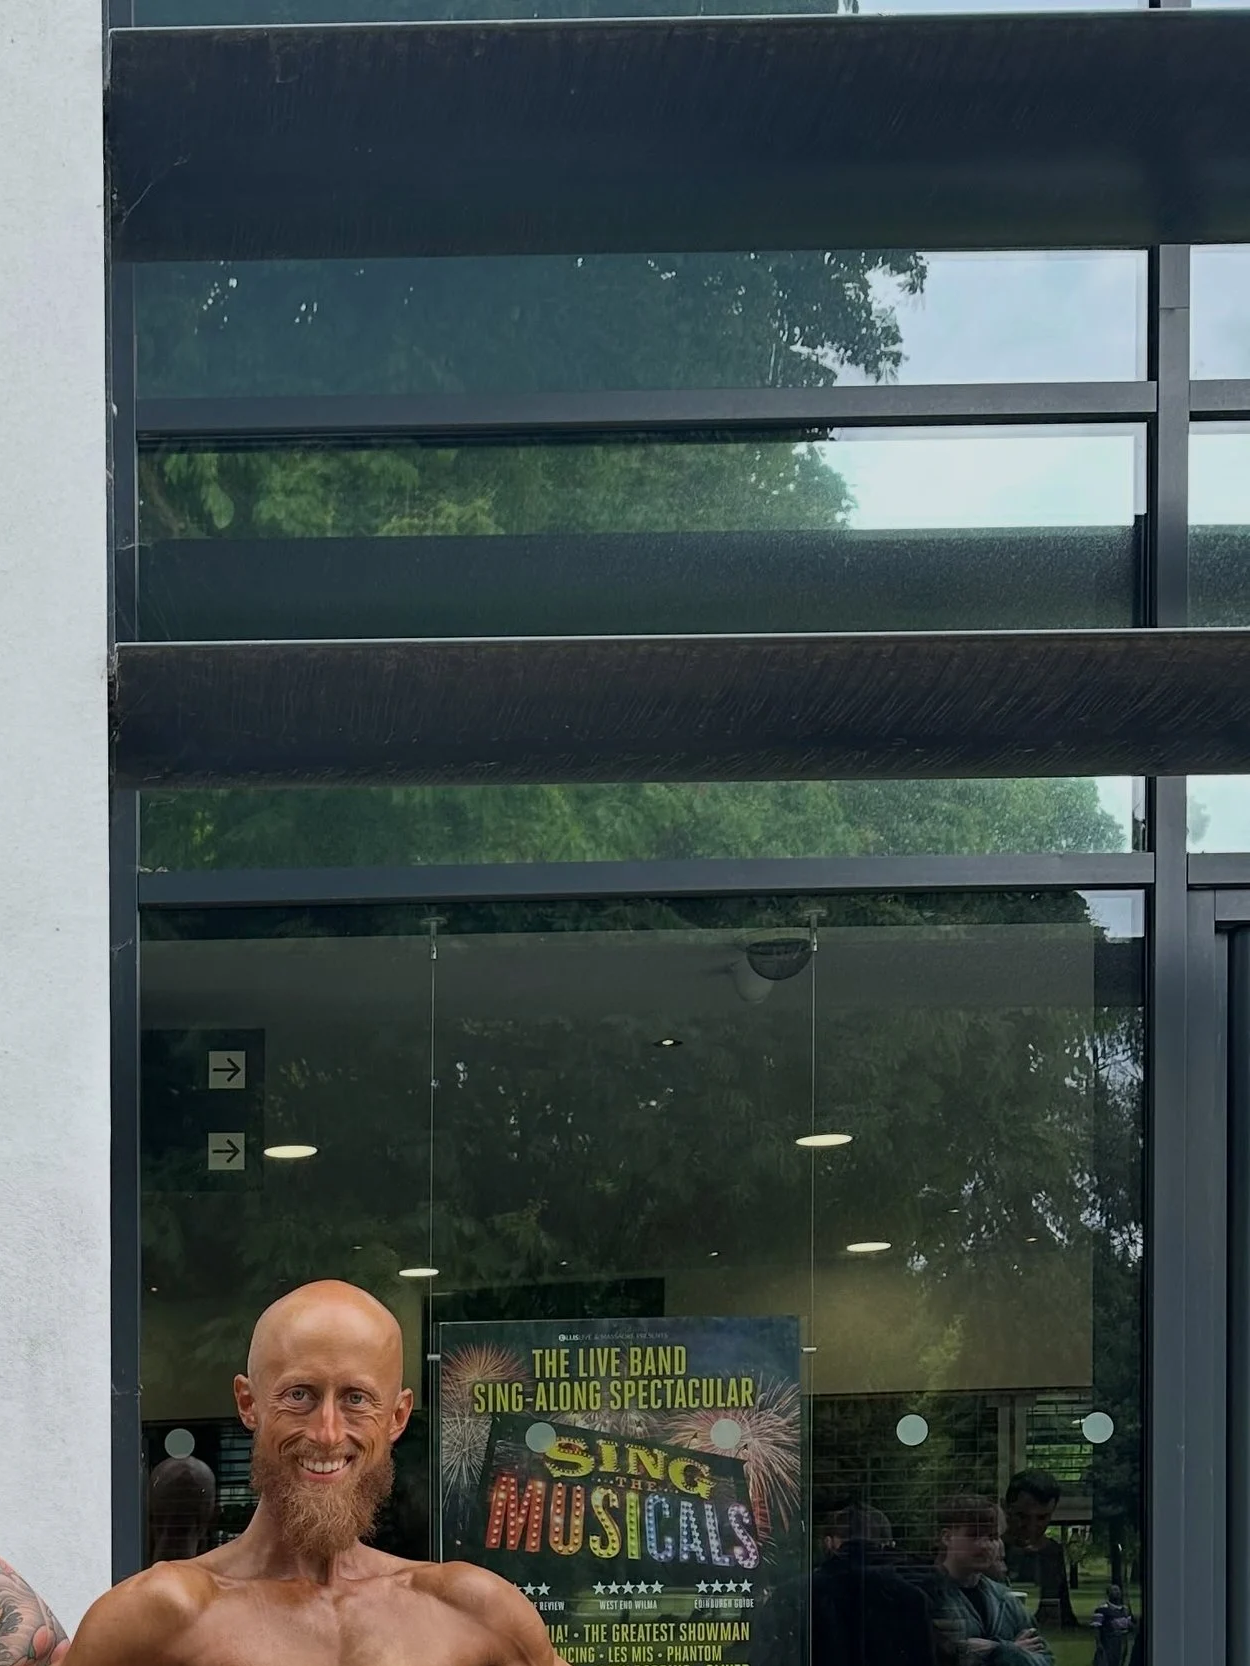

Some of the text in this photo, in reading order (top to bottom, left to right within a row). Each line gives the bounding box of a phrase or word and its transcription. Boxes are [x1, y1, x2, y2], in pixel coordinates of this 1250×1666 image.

[532, 1346, 686, 1379] THE LIVE BAND
[473, 1378, 754, 1413] SING-ALONG SPECTACULAR
[544, 1436, 716, 1499] SING
[485, 1474, 760, 1569] MUSICALS
[539, 1601, 565, 1611] REVIEW
[599, 1600, 658, 1611] WEST END WILMA
[694, 1597, 755, 1609] EDINBURGH GUIDE
[584, 1624, 607, 1643] THE
[612, 1623, 675, 1642] GREATEST
[679, 1622, 750, 1642] SHOWMAN
[608, 1646, 628, 1663] LES
[631, 1646, 654, 1663] MIS
[666, 1645, 722, 1662] PHANTOM
